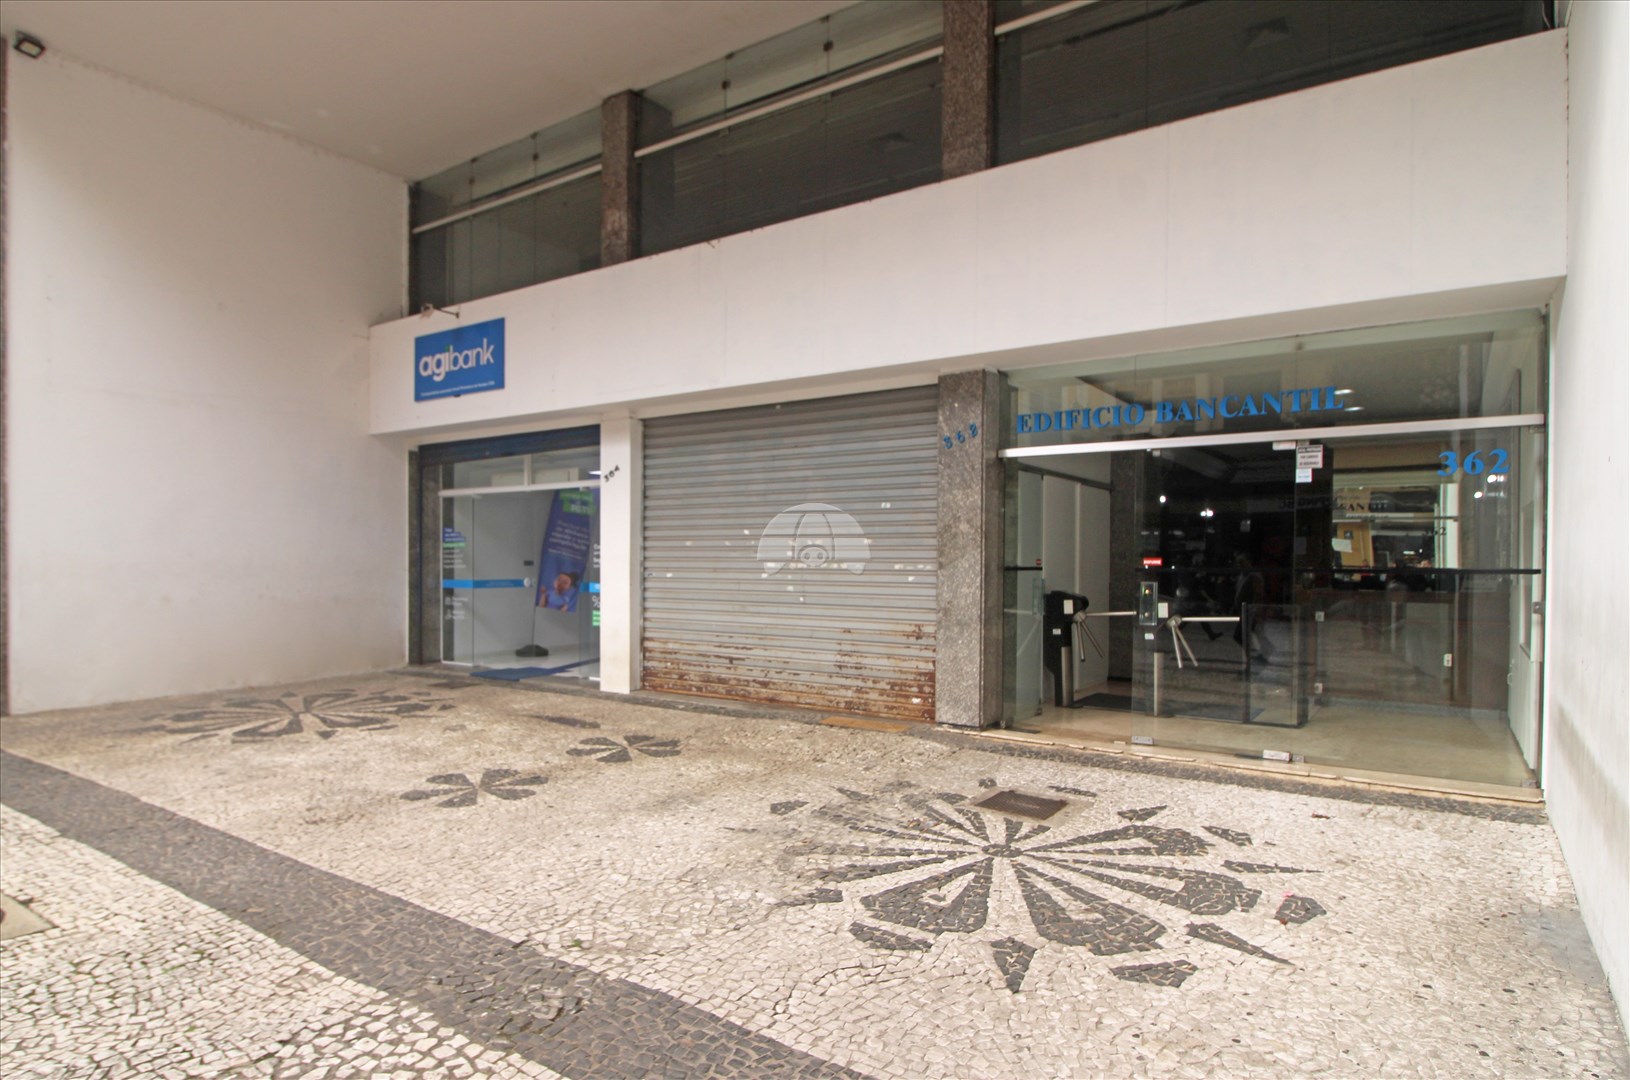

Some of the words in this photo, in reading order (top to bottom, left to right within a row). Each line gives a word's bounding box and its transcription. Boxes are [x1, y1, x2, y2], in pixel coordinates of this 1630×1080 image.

[419, 338, 495, 382] agibank
[1016, 403, 1146, 434] EDIFICIO
[1155, 386, 1344, 424] BANCANTIL
[1437, 448, 1511, 477] 362
